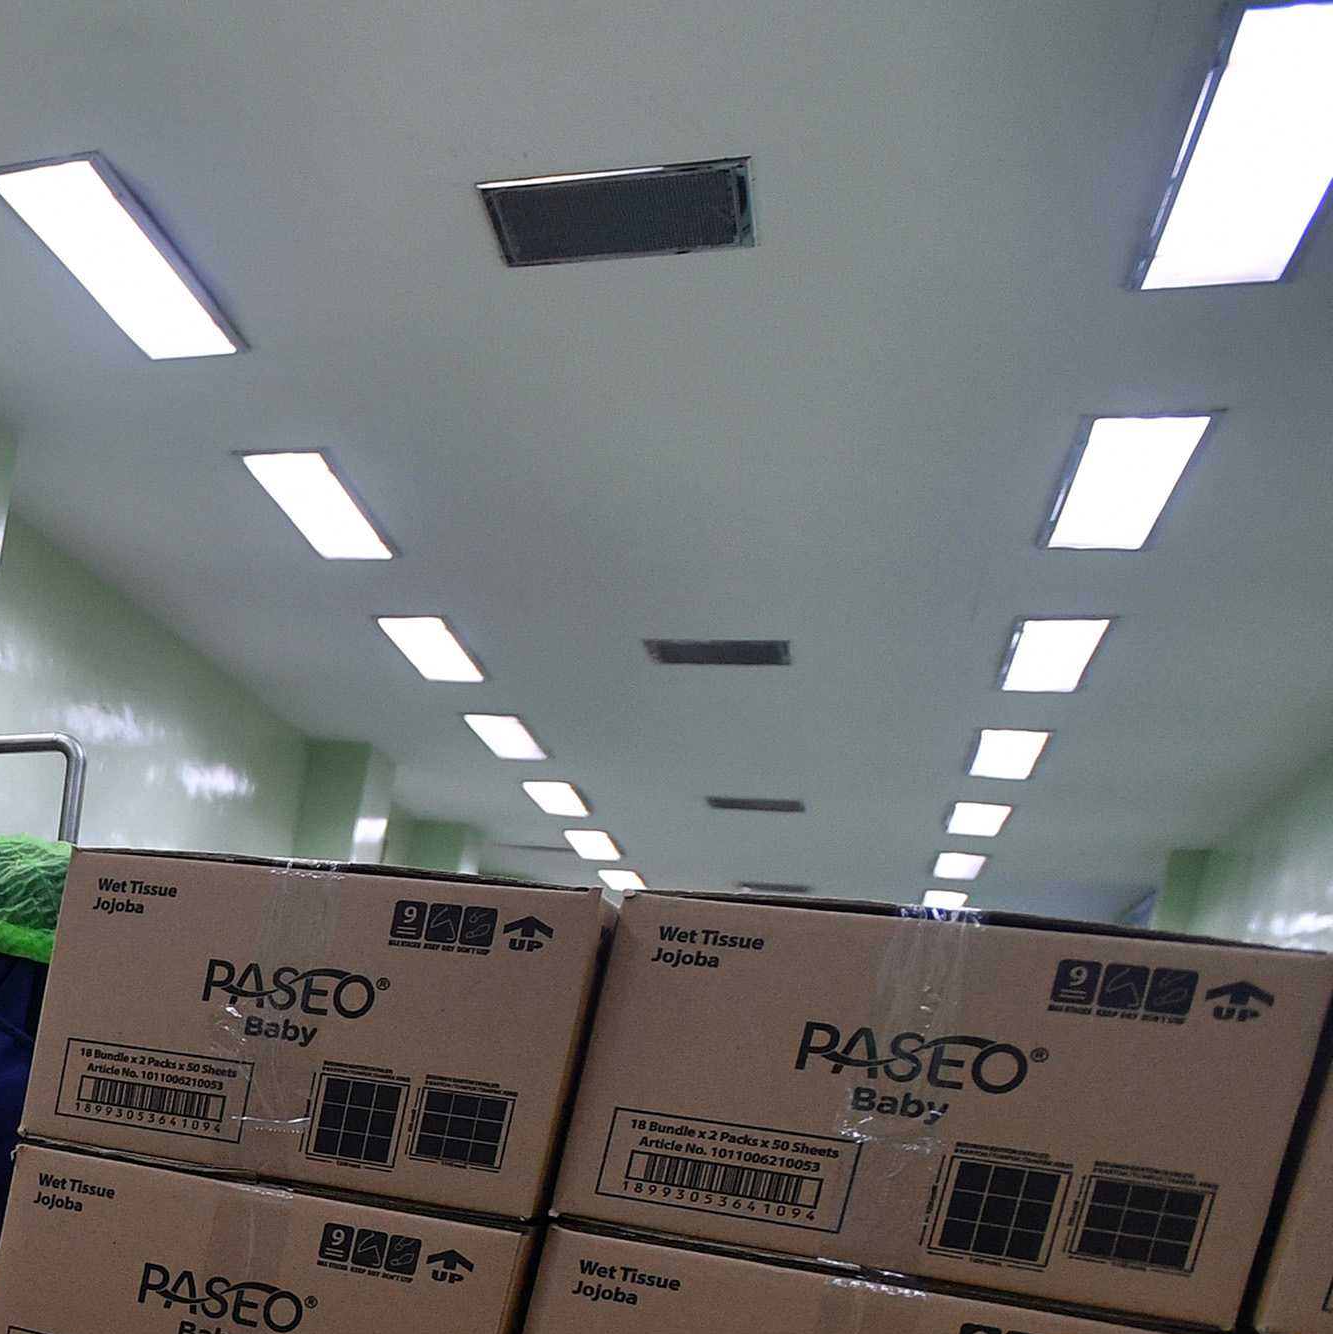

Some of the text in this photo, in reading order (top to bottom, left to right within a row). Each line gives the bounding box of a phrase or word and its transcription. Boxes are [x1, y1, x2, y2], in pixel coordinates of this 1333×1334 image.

[97, 876, 178, 899] Wet Tissue
[92, 896, 145, 915] Jojoba
[403, 905, 418, 924] 9
[507, 937, 544, 953] UP
[659, 924, 766, 951] Wet Tissue
[650, 946, 720, 969] Jojoba
[1069, 965, 1089, 987] 9
[1211, 1004, 1260, 1023] UP
[243, 1014, 319, 1049] Baby
[80, 1046, 94, 1058] 18
[93, 1048, 130, 1064] Bundle
[137, 1055, 147, 1066] 2
[146, 1056, 178, 1071] Packs
[185, 1062, 201, 1074] 50
[200, 1064, 238, 1079] Sheets
[85, 1061, 225, 1092] Article No. 1011006210053
[849, 1086, 950, 1127] Baby
[630, 1118, 648, 1131] 18
[647, 1120, 696, 1139] Bundle
[707, 1129, 719, 1142] 2
[718, 1131, 759, 1148] Packs
[770, 1139, 791, 1152] 50
[790, 1141, 840, 1160] Sheets
[637, 1135, 821, 1174] Article No. 1011006210053
[38, 1171, 116, 1200] Wet Tissue
[32, 1190, 84, 1213] Jojoba
[331, 1228, 346, 1246] 9
[430, 1268, 465, 1285] UP
[579, 1258, 682, 1292] Wet Tissue
[571, 1279, 639, 1306] Jojoba
